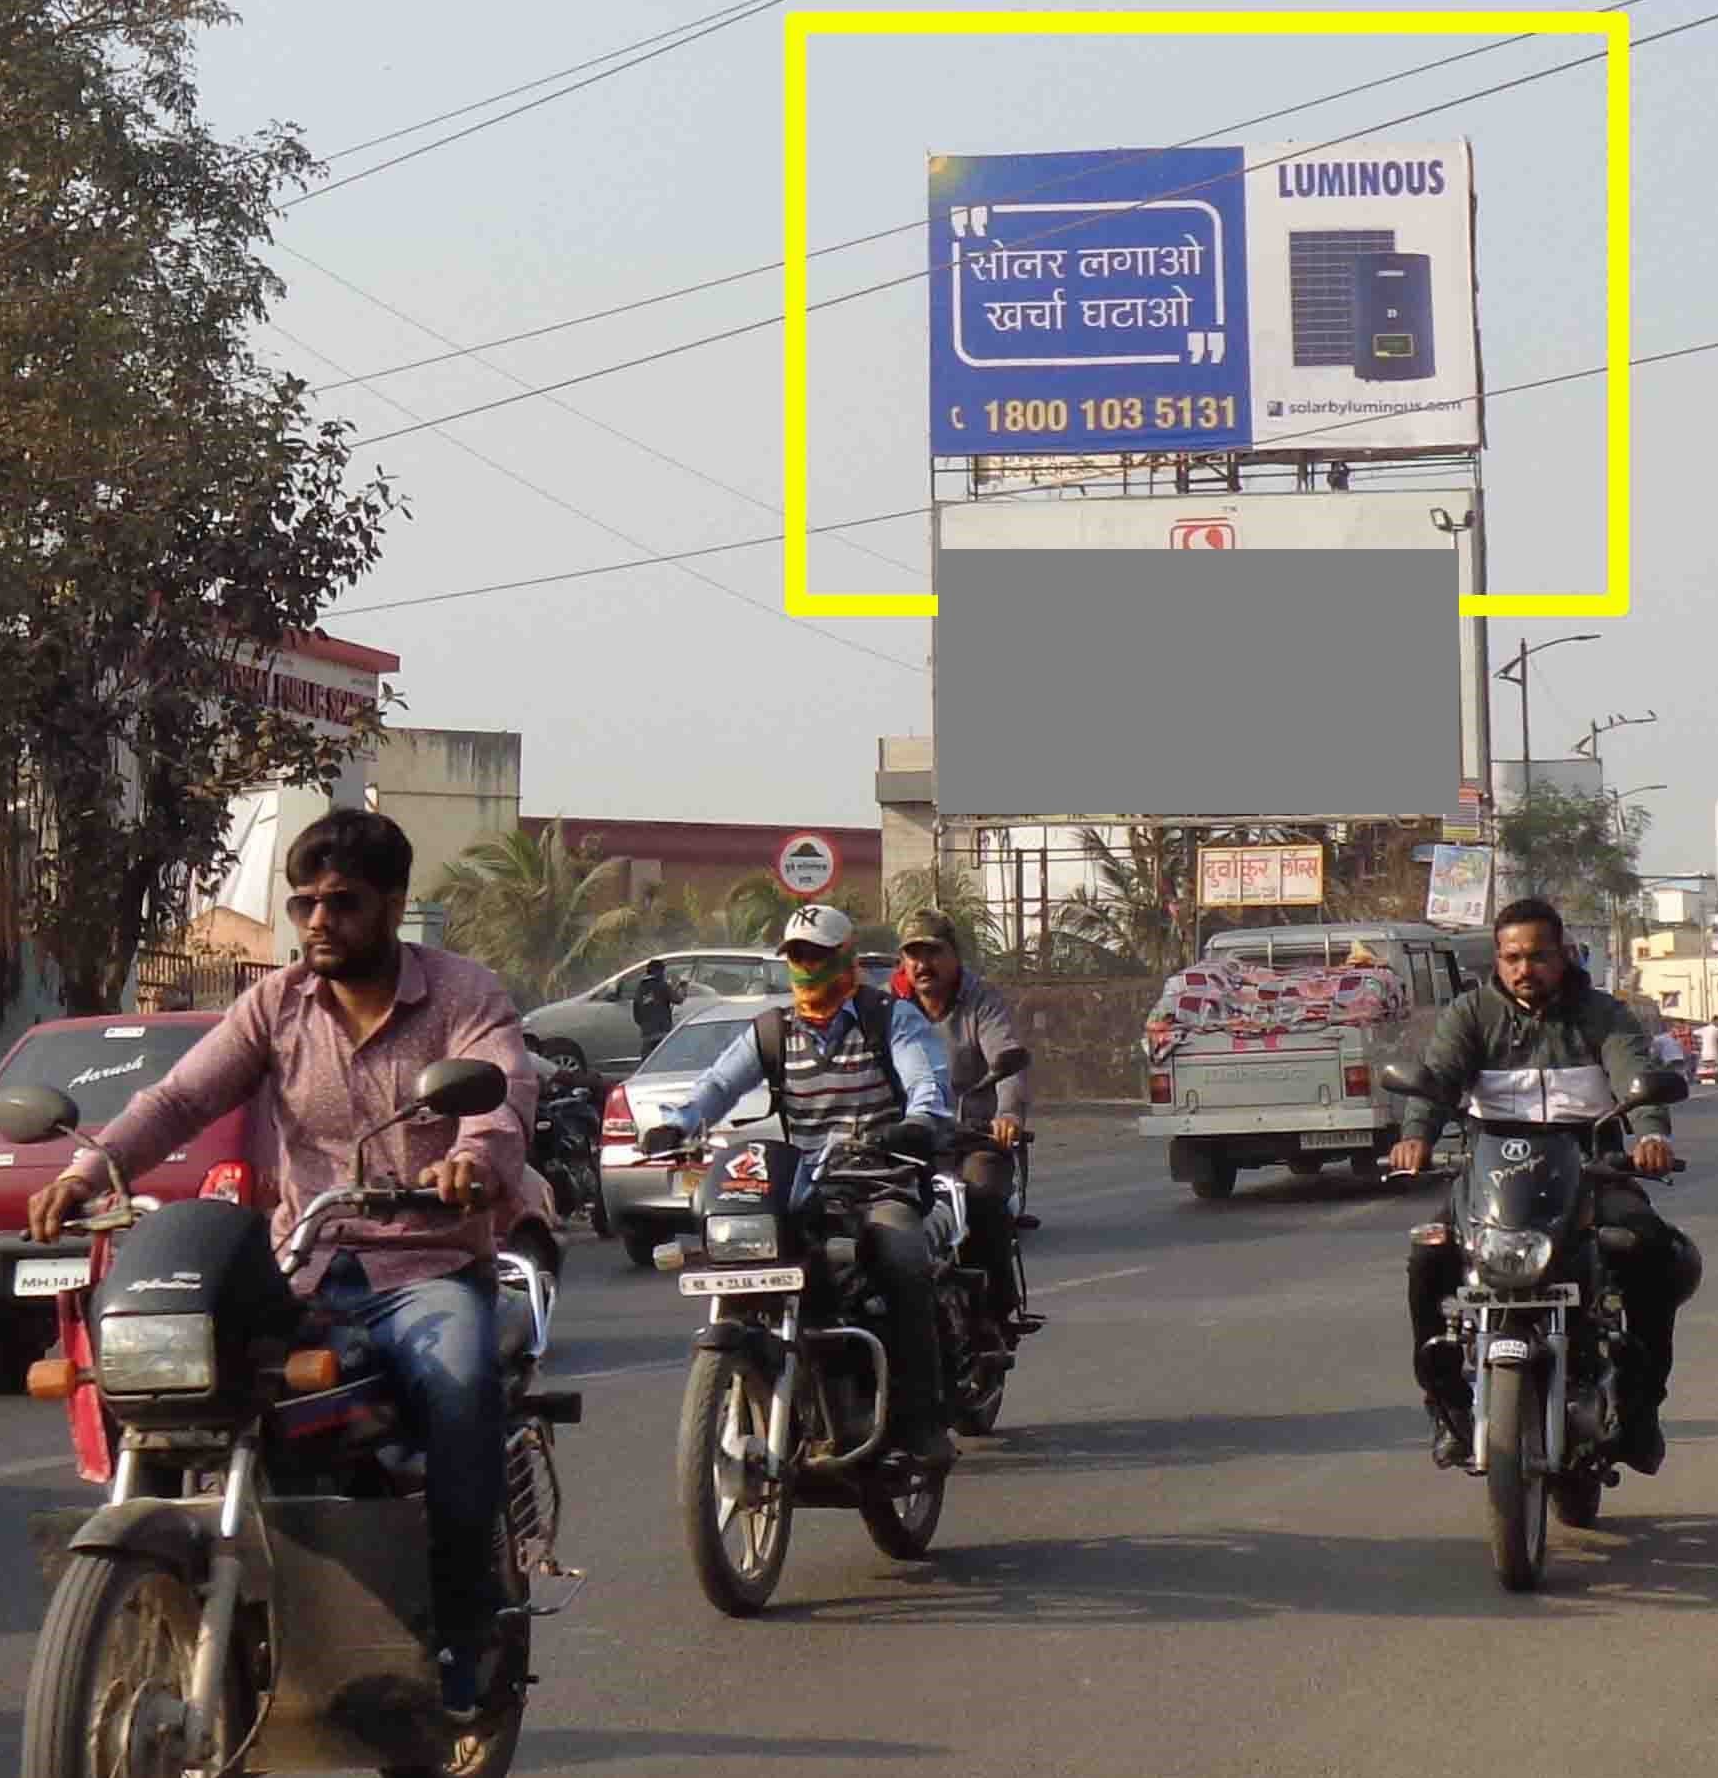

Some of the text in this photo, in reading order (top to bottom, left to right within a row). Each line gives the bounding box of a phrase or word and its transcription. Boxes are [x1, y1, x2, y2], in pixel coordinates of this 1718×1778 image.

[1278, 160, 1445, 198] LUMINOUS
[966, 233, 1205, 281] सोलर लगाओ
[982, 285, 1194, 331] खर्चा घटाओ
[985, 395, 1237, 432] 1800 103 5131
